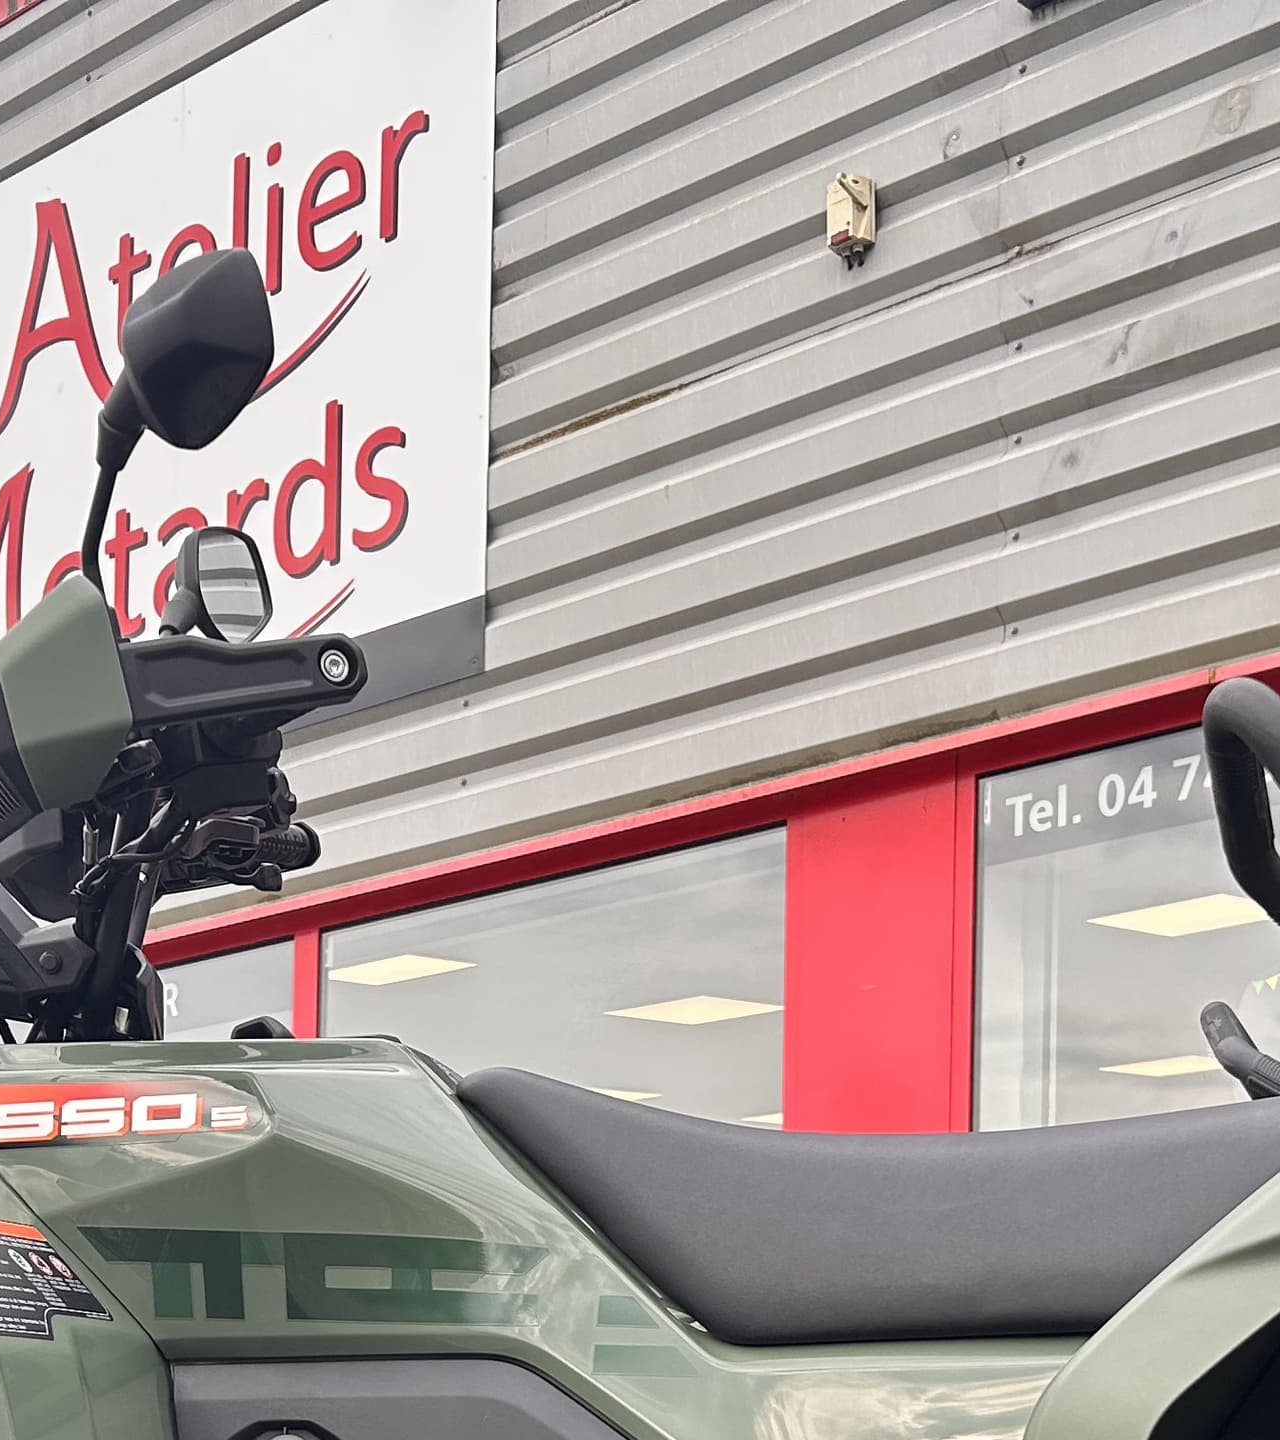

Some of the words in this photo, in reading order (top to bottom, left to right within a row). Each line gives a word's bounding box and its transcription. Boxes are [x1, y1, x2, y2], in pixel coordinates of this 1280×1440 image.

[1005, 783, 1082, 837] Tel.
[1098, 765, 1157, 817] 04
[1172, 754, 1212, 801] 7
